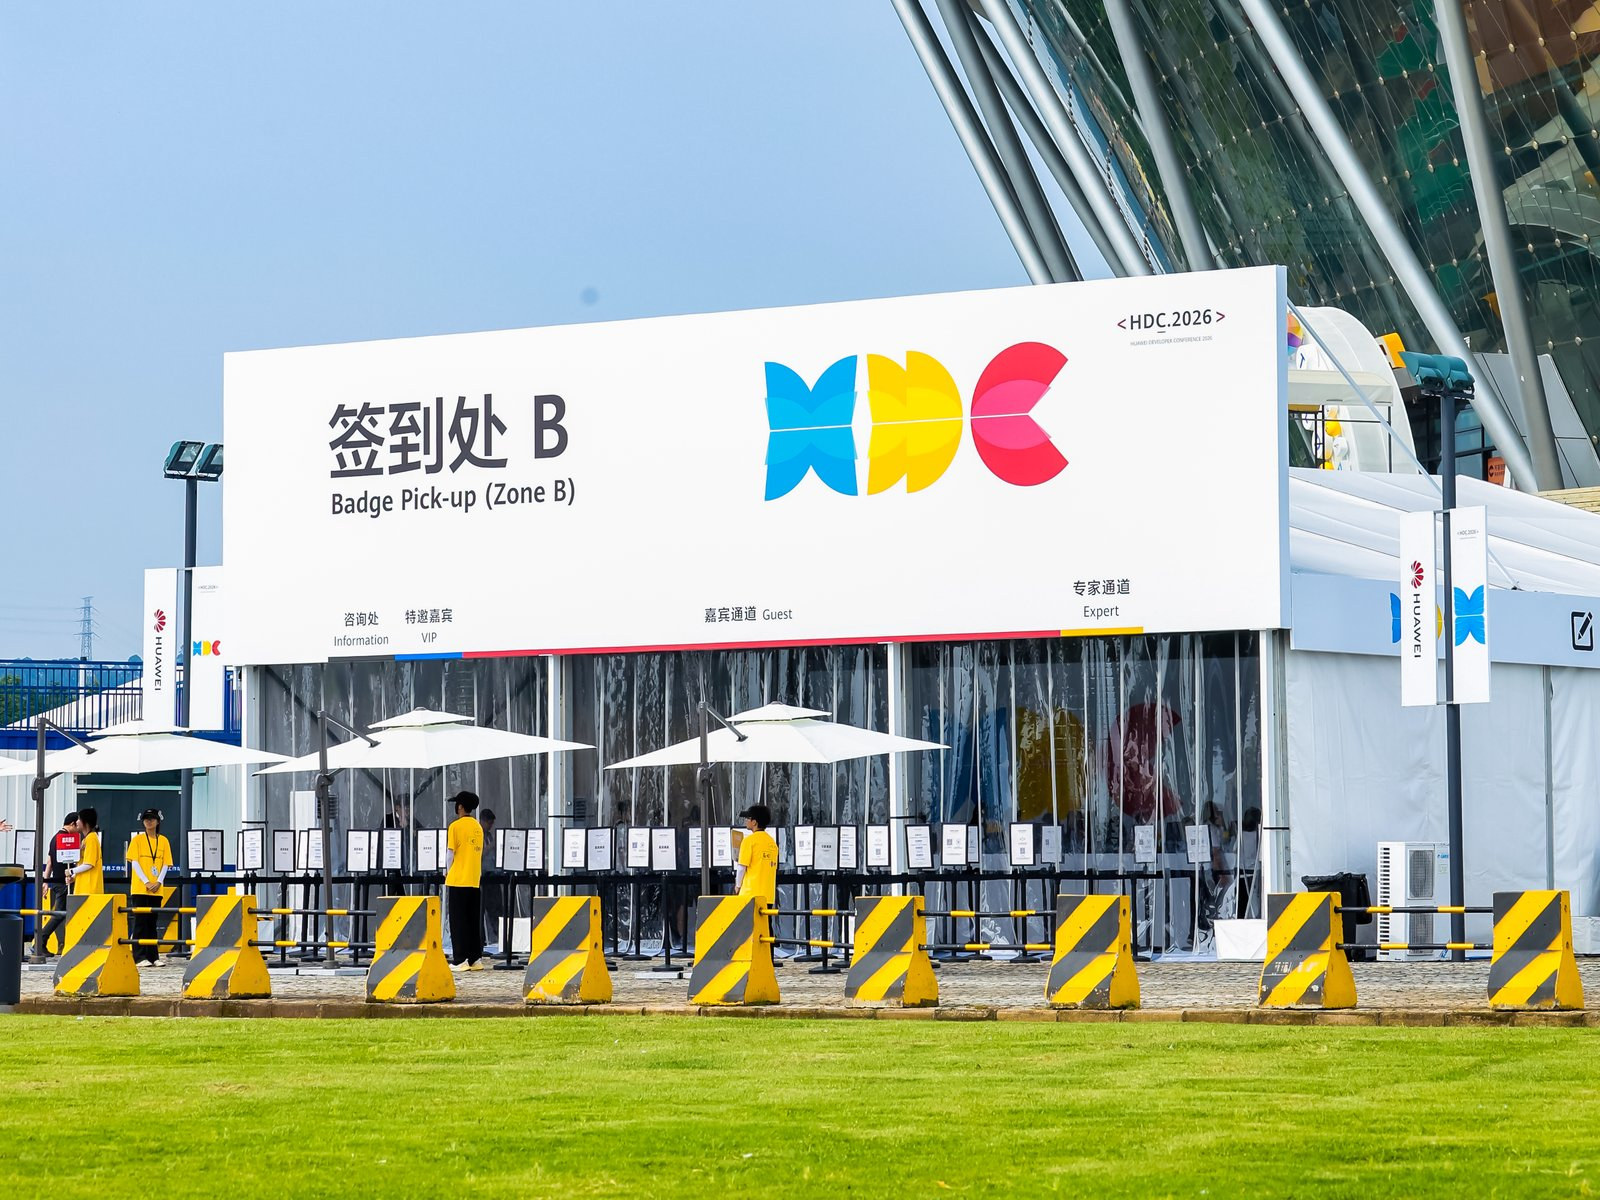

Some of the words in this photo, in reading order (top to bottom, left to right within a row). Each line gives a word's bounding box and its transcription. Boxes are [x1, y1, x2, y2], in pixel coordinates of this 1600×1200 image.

[328, 393, 509, 479] 签到处
[533, 393, 569, 460] B
[331, 489, 394, 519] Badge
[401, 485, 477, 514] Pick-up
[485, 481, 546, 511] (Zone
[554, 477, 576, 506] B)
[1072, 578, 1131, 597] 专家通道
[344, 611, 379, 627] 咨询处
[404, 607, 453, 625] 特邀嘉宾
[704, 605, 757, 624] 嘉宾通道
[762, 608, 793, 621] Guest
[1083, 605, 1120, 620] Expert
[1412, 593, 1422, 658] HUAWEI
[334, 634, 389, 647] Information
[421, 631, 438, 643] VIP
[154, 636, 162, 691] HUAWEI
